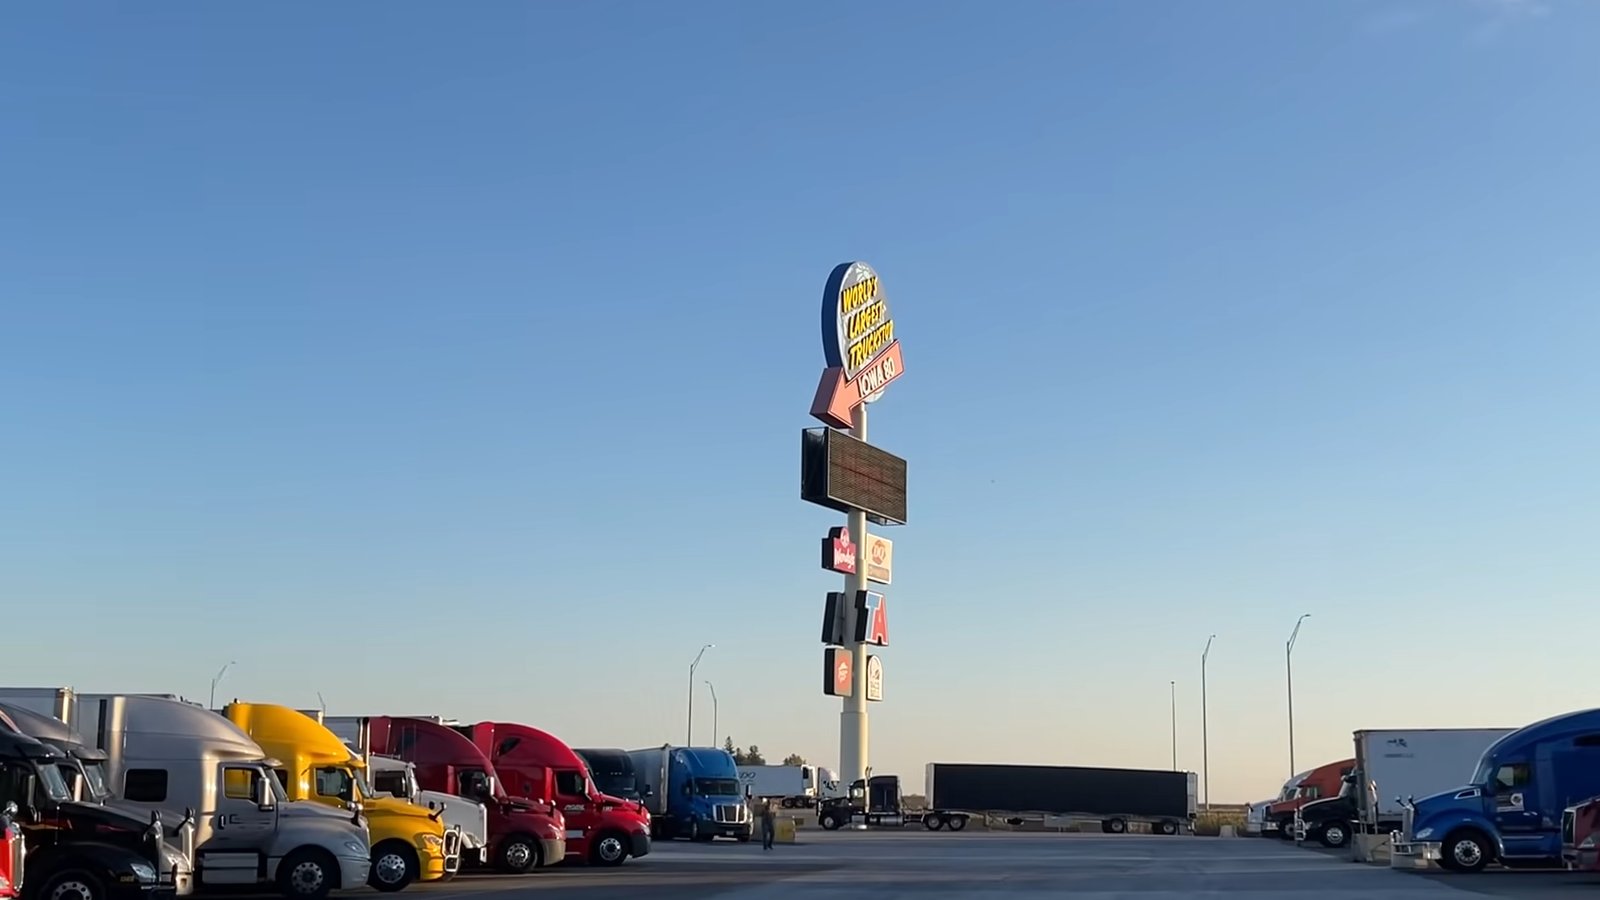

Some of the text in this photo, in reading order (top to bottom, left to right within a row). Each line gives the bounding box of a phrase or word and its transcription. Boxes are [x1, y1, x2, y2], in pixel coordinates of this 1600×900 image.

[847, 300, 884, 340] LARGEST
[857, 356, 896, 398] IOWA 80
[865, 590, 889, 646] TA
